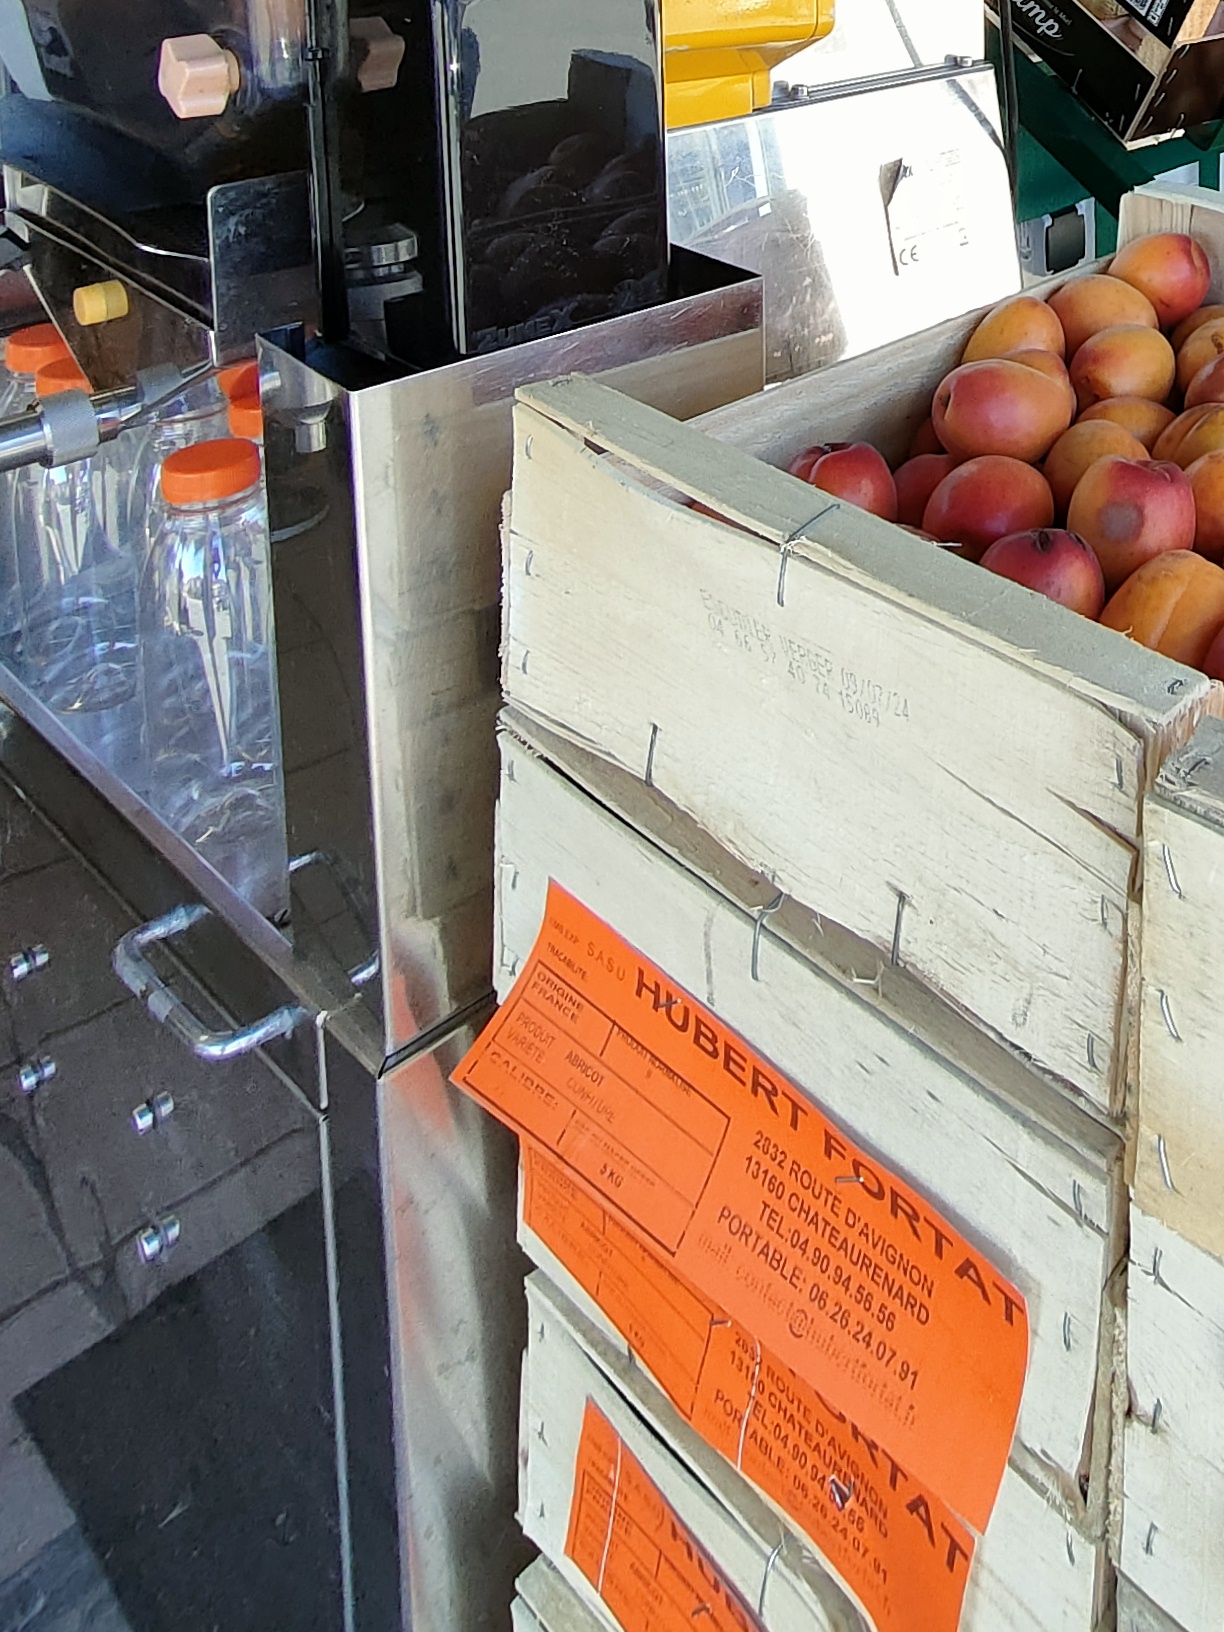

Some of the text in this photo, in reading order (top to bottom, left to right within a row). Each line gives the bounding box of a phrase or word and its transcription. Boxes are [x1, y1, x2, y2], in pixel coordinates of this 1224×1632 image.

[530, 981, 580, 1024] FRANCE
[536, 970, 585, 1012] ORIGINE
[515, 1013, 605, 1088] PRODUIT ABRICOT
[635, 967, 809, 1133] HUBERT
[608, 1170, 624, 1189] KG
[744, 1154, 931, 1326] 13160 CHATEAURENARD
[788, 1160, 842, 1218] ROUTE
[844, 1208, 935, 1299] D'AVIGNON
[716, 1205, 919, 1392] PORTABLE: 06.26.24.07.91
[766, 1363, 812, 1426] ROUTE
